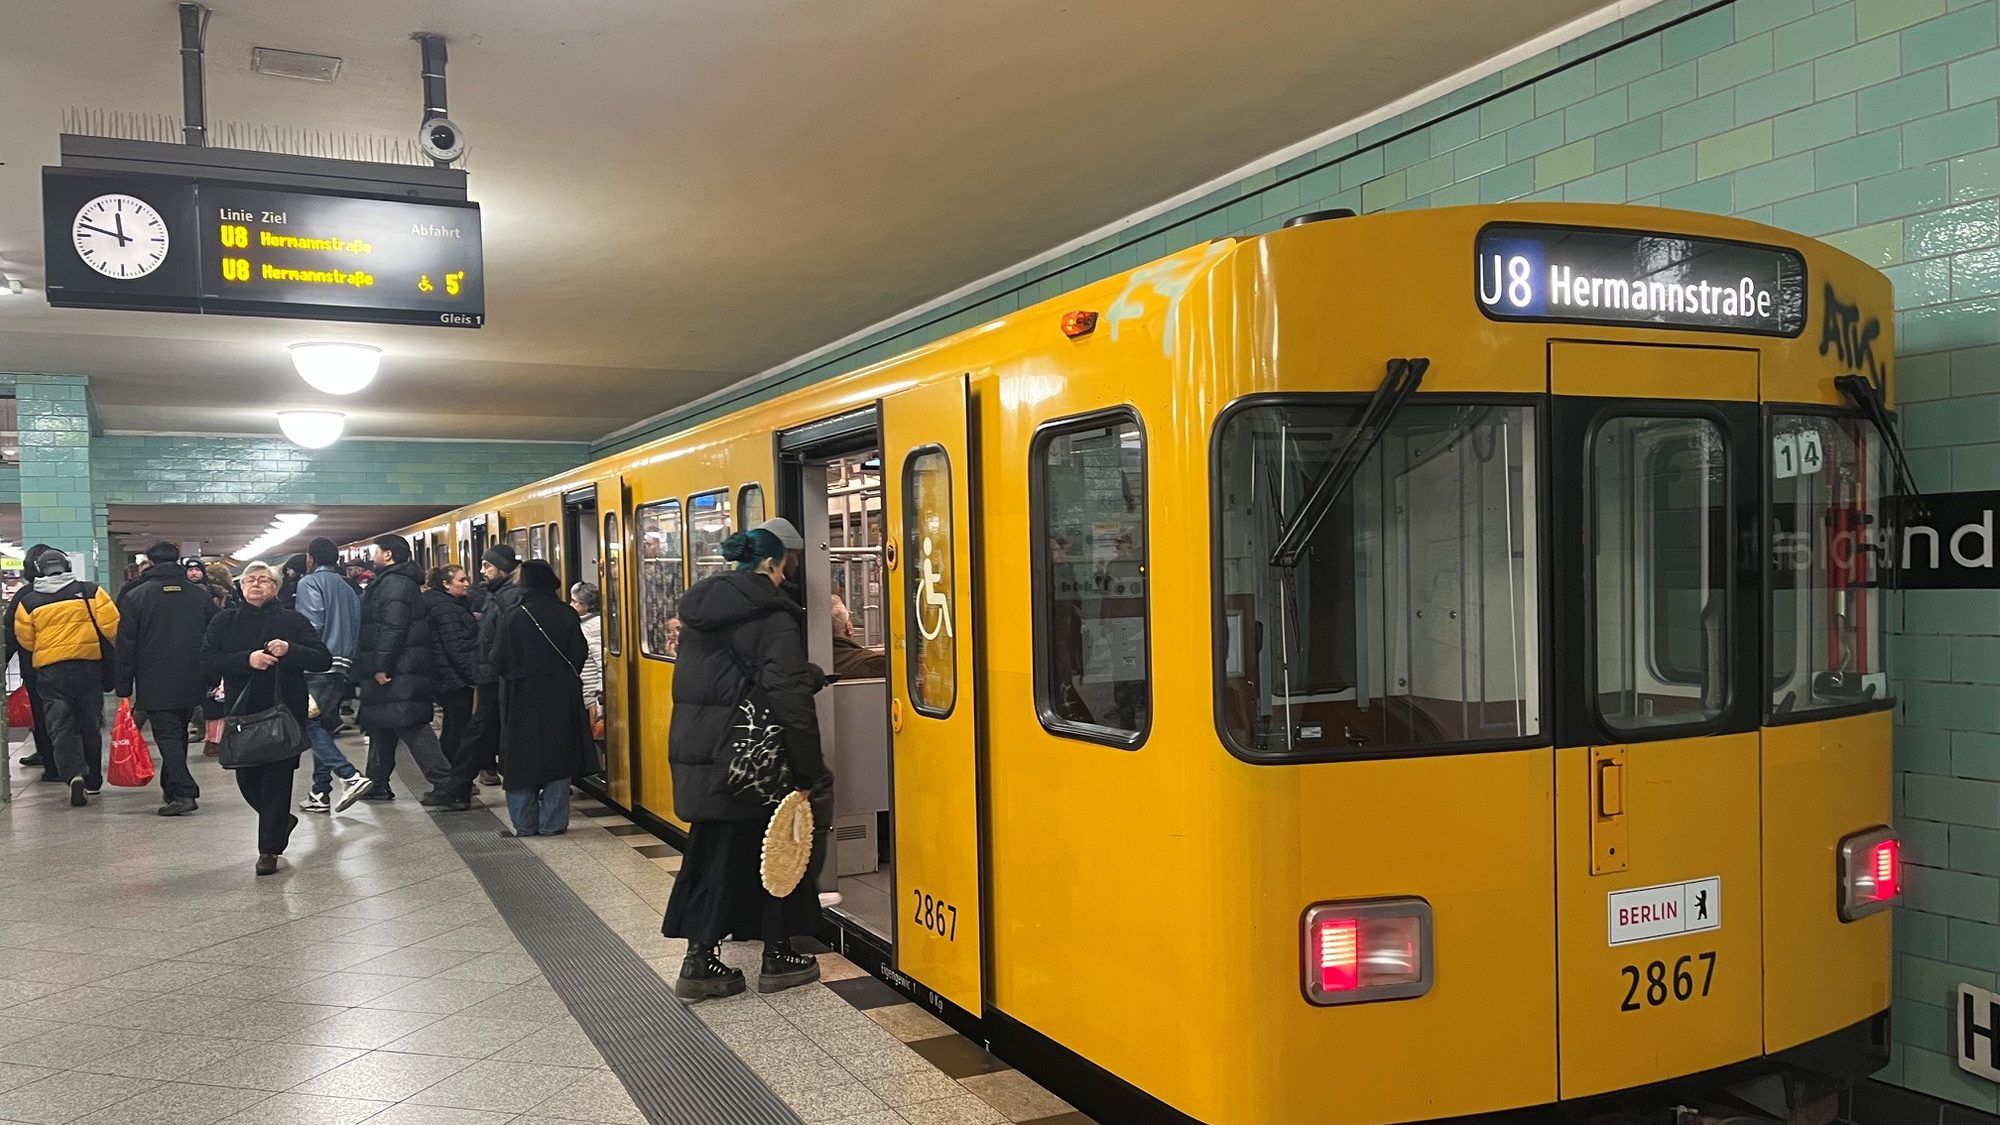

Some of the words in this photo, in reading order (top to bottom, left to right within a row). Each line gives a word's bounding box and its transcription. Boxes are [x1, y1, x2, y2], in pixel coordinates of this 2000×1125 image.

[220, 208, 254, 223] Linie
[261, 211, 287, 225] Ziel
[220, 225, 248, 249] U8
[411, 223, 461, 239] Abfahrt
[222, 258, 250, 282] U8
[1479, 252, 1533, 308] U8
[1550, 264, 1772, 318] Hermannstraße
[440, 313, 472, 325] Gleis
[475, 315, 482, 325] 1
[914, 889, 957, 942] 2867
[1619, 901, 1678, 926] BERLIN
[1621, 951, 1717, 1012] 2867
